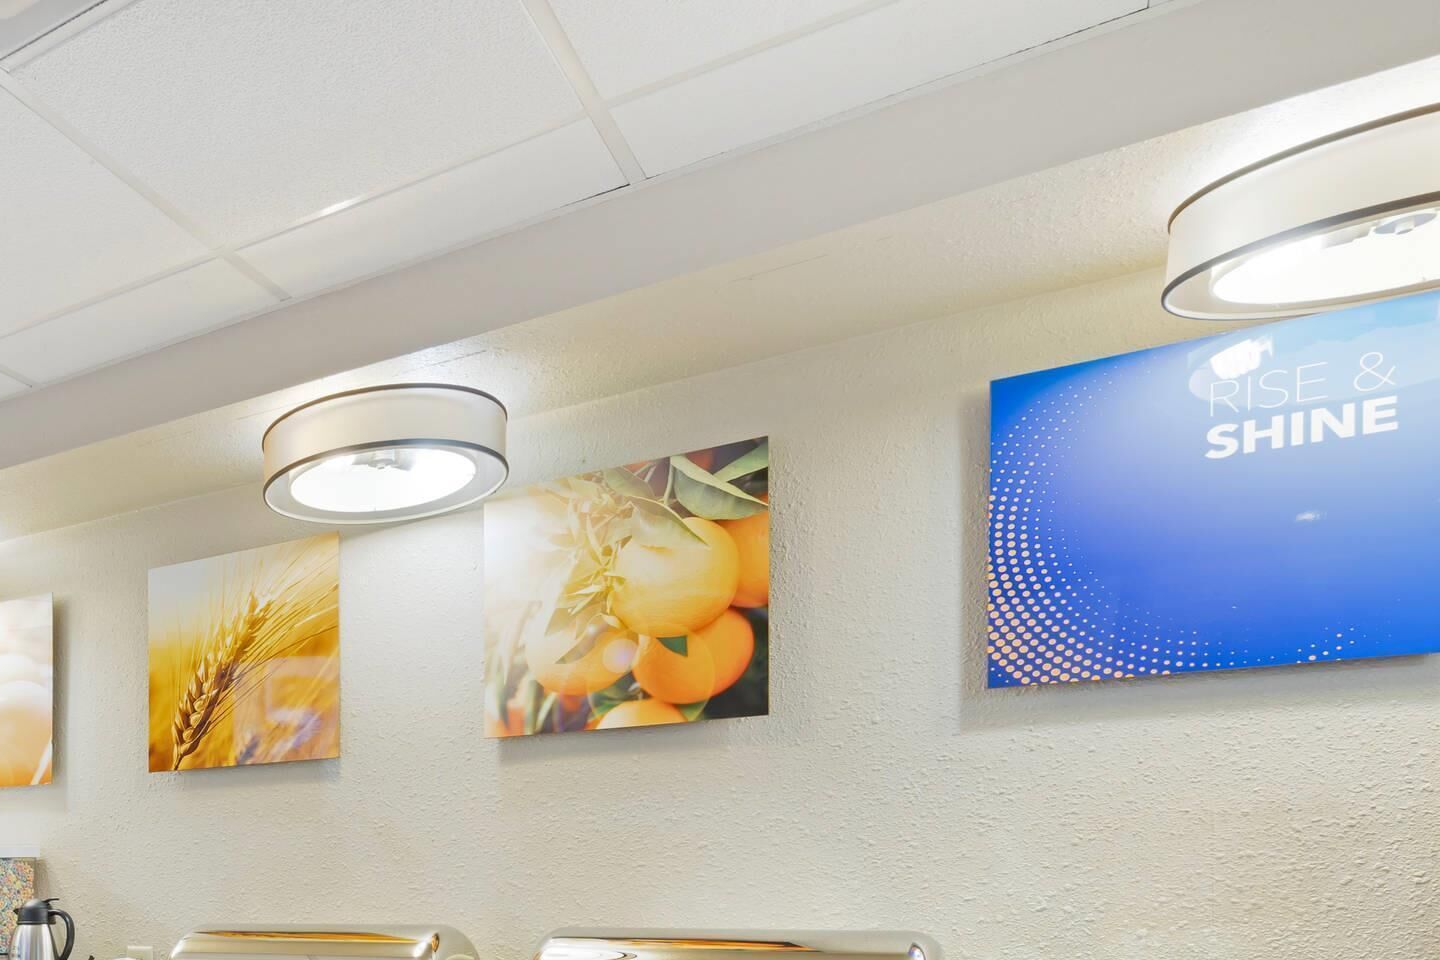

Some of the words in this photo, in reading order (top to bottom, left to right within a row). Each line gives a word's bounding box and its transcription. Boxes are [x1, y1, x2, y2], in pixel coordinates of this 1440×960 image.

[1209, 361, 1329, 417] RISE
[1353, 351, 1397, 392] &
[1204, 395, 1400, 460] SHINE
